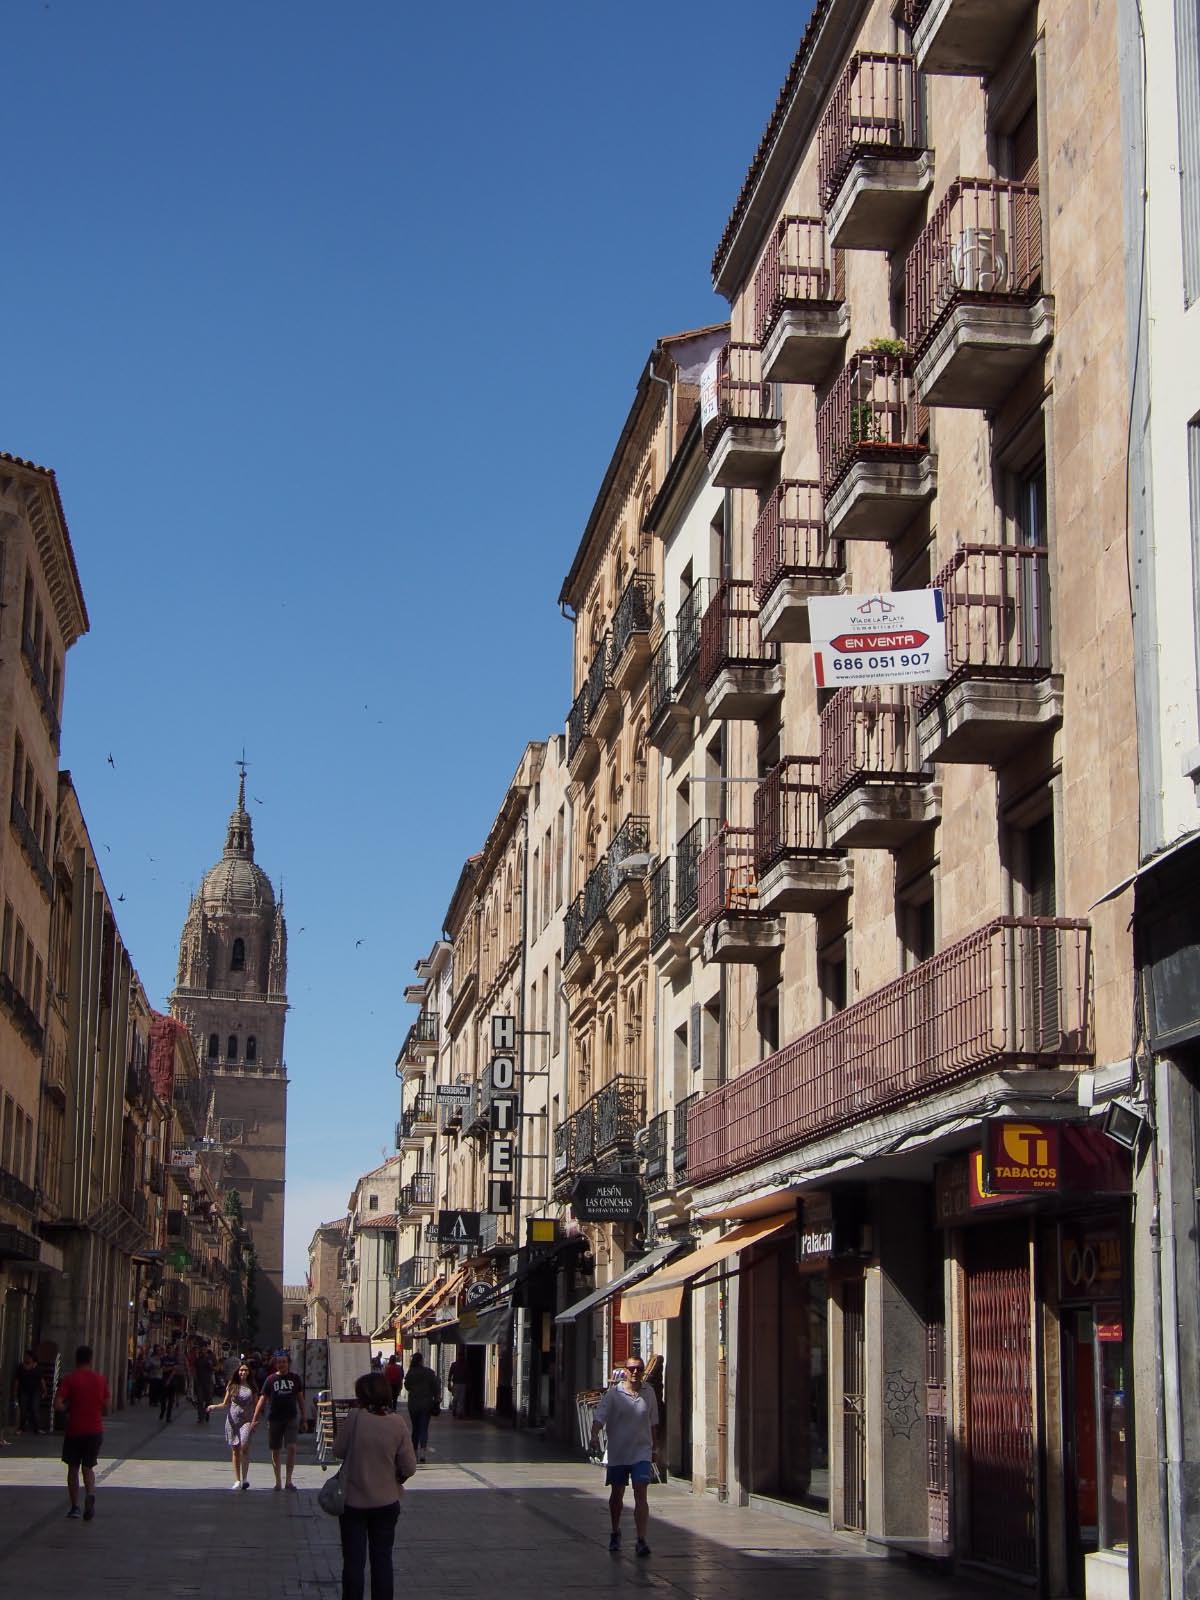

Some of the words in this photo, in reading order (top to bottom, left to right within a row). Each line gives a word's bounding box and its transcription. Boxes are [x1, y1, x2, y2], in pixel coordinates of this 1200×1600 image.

[845, 638, 863, 648] EN
[867, 635, 914, 647] VENTA
[833, 658, 863, 670] 686
[868, 656, 895, 669] 051
[900, 653, 930, 666] 907
[440, 1086, 467, 1095] RESIDENCIA
[492, 1018, 514, 1213] HOTEL
[995, 1167, 1057, 1178] TABACOS
[597, 1185, 622, 1196] MESÓN
[585, 1198, 599, 1207] LAS
[600, 1198, 633, 1207] CONCHAS
[273, 1379, 295, 1392] GAP
